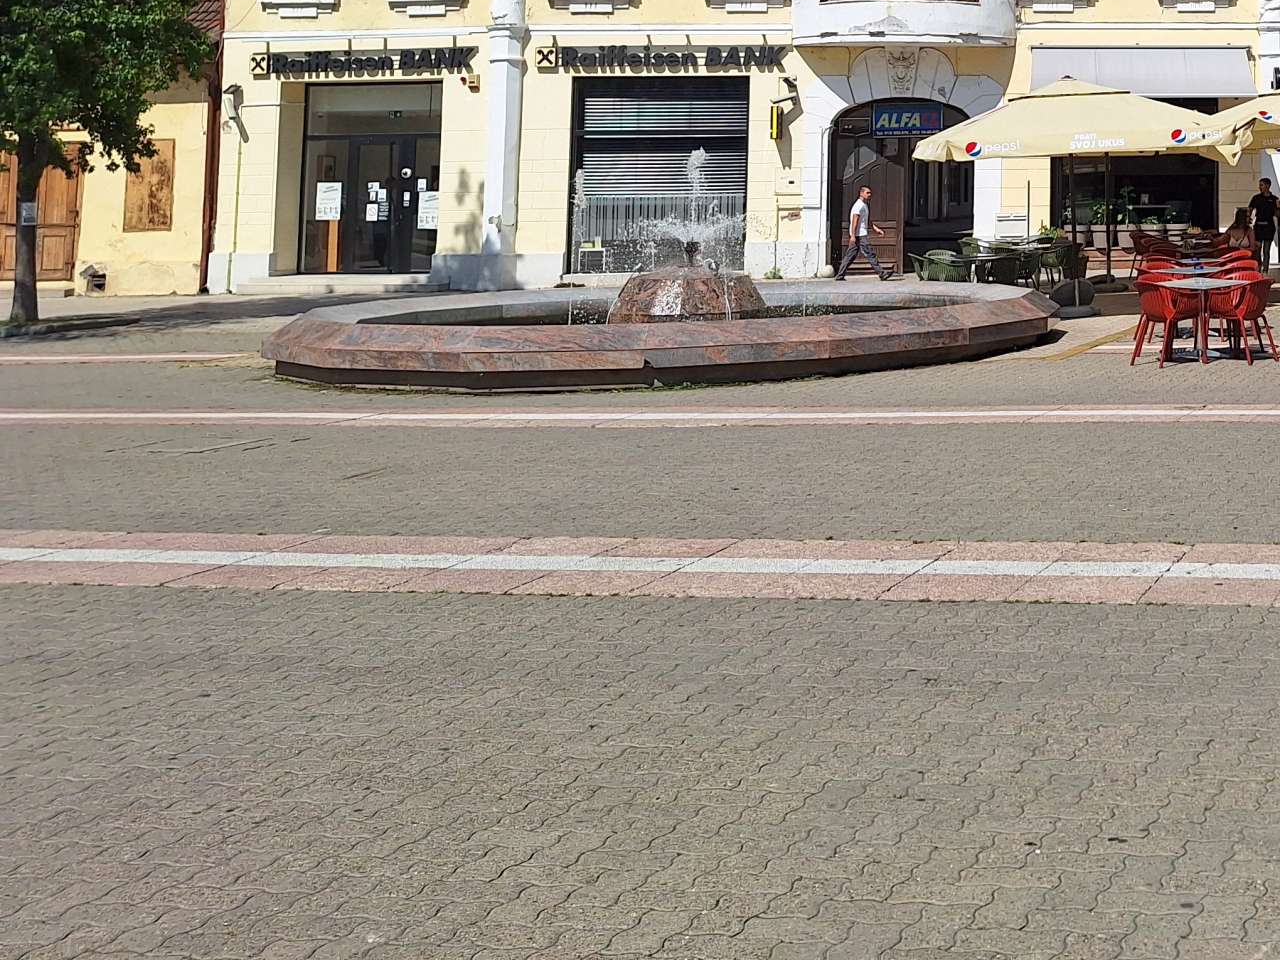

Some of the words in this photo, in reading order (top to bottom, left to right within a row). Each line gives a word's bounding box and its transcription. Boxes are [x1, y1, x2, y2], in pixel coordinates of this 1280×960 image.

[272, 51, 394, 73] Raiffeisen
[399, 46, 475, 70] BANK
[561, 45, 699, 68] Raiffeisen
[704, 46, 787, 67] BANK
[876, 112, 921, 129] ALFA
[985, 140, 1020, 155] pepsi
[1070, 140, 1096, 150] SVOJ
[1098, 138, 1125, 148] UKUS
